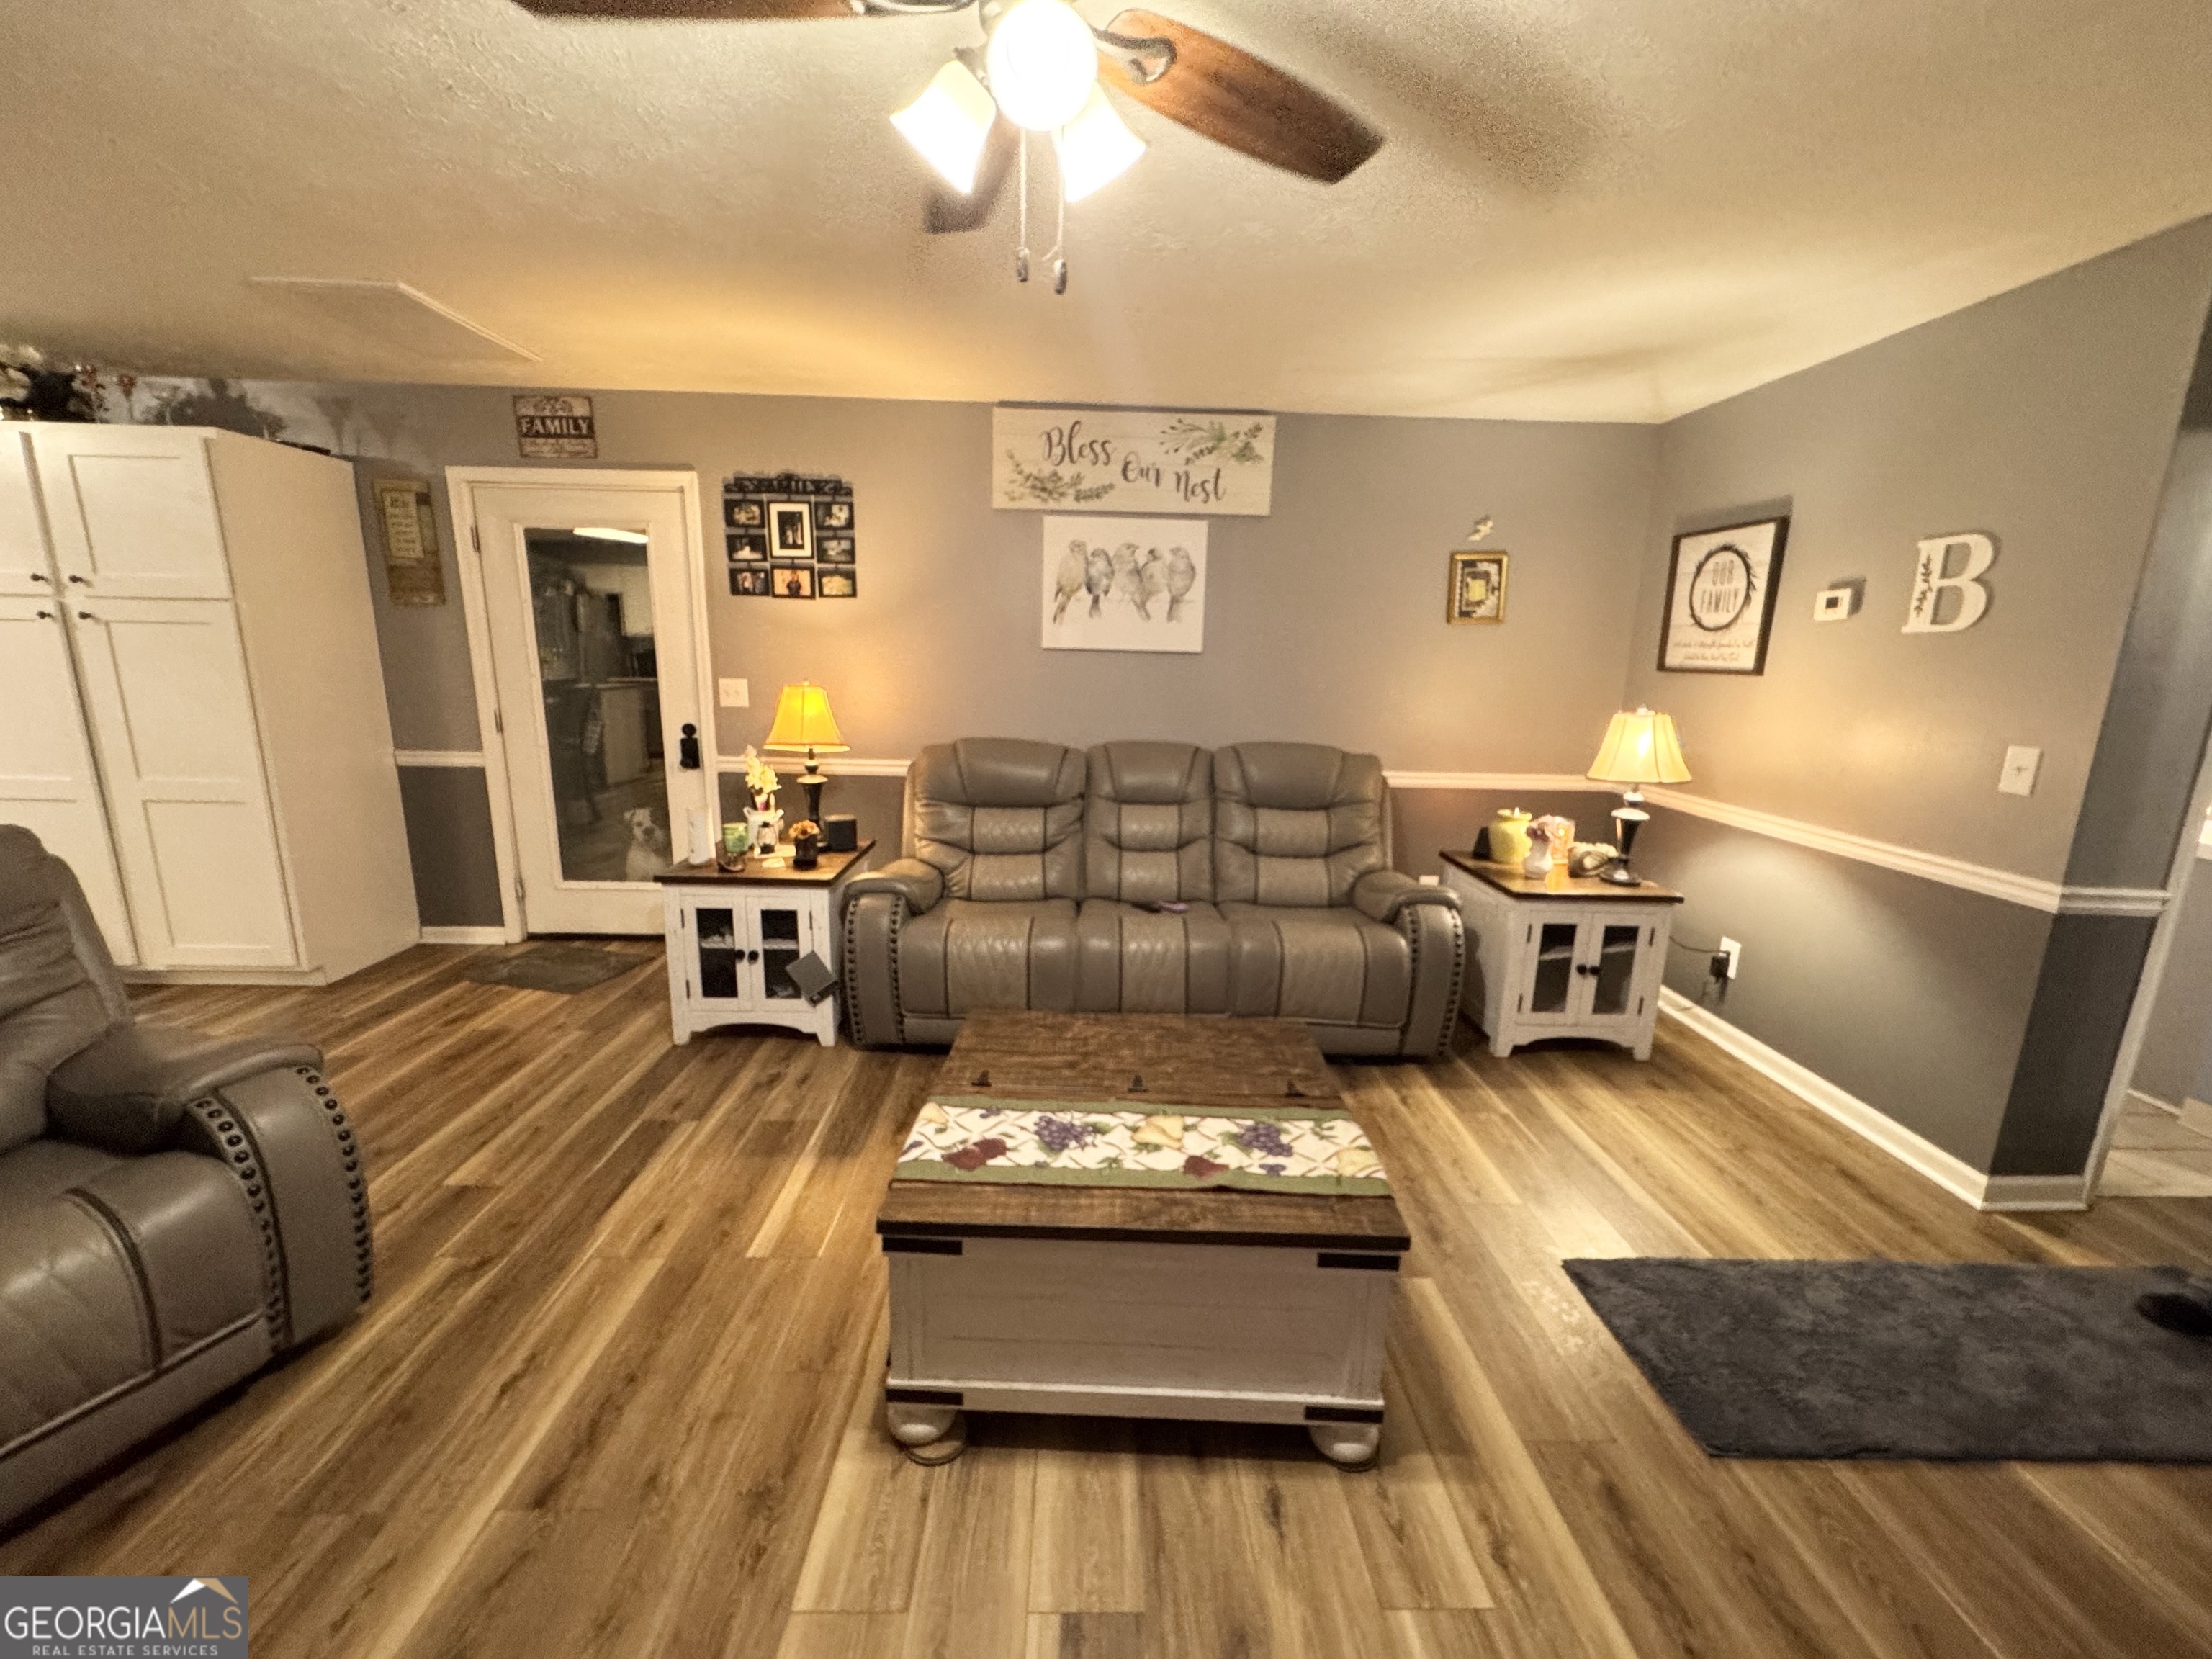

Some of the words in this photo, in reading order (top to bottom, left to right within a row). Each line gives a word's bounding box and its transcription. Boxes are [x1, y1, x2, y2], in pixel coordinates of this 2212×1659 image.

[521, 418, 589, 434] FAMILY
[1041, 420, 1113, 467] Bless
[1120, 451, 1161, 489] Our
[1699, 587, 1740, 613] FAMILY
[1902, 534, 1993, 633] B
